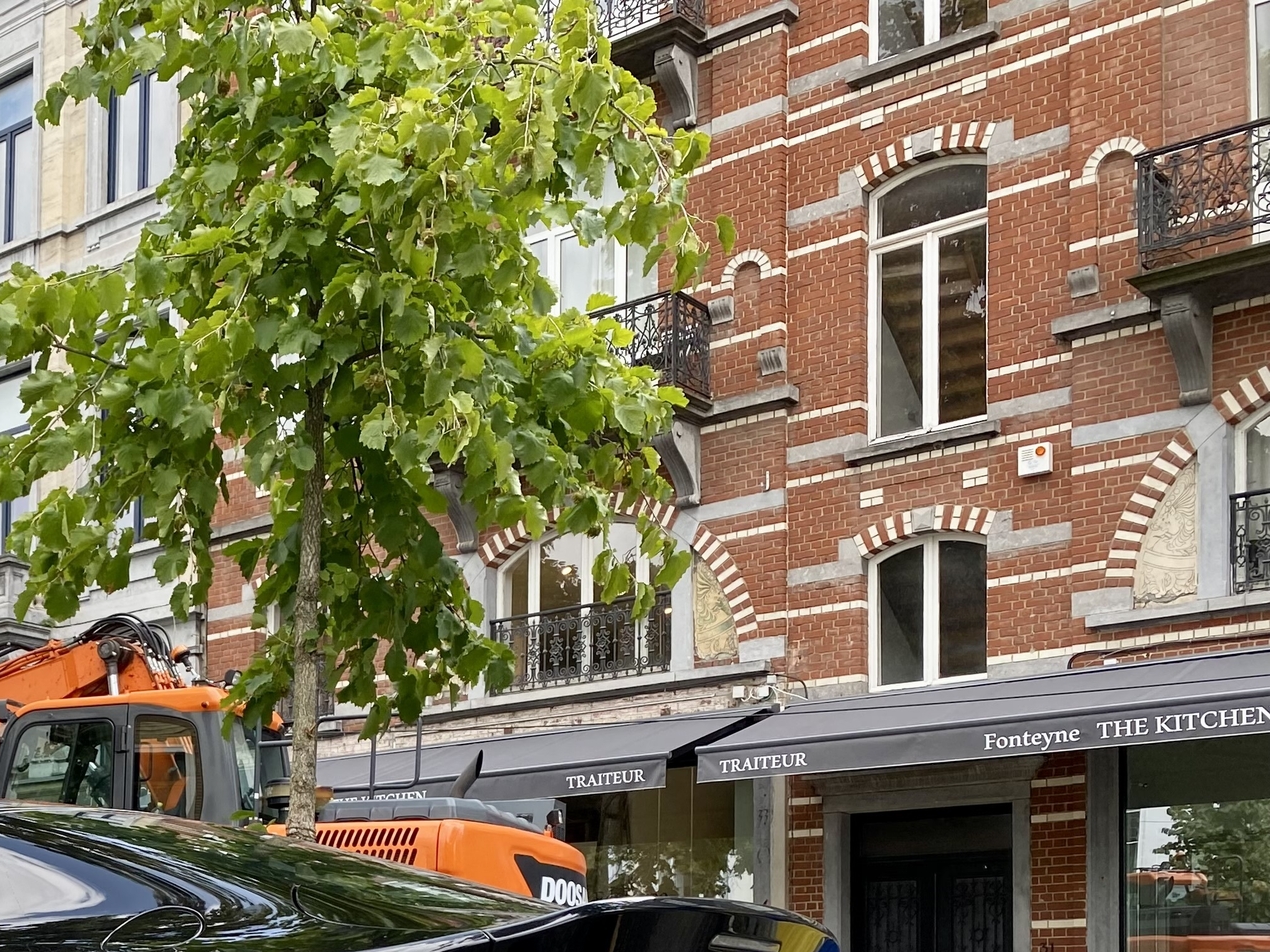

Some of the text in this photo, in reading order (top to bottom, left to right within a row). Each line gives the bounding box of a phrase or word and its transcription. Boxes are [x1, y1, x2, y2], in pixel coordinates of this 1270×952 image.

[983, 728, 1081, 751] Fonteyne
[1096, 717, 1149, 740] THE
[719, 752, 808, 773] TRAITEUR
[565, 769, 646, 789] TRAITEUR
